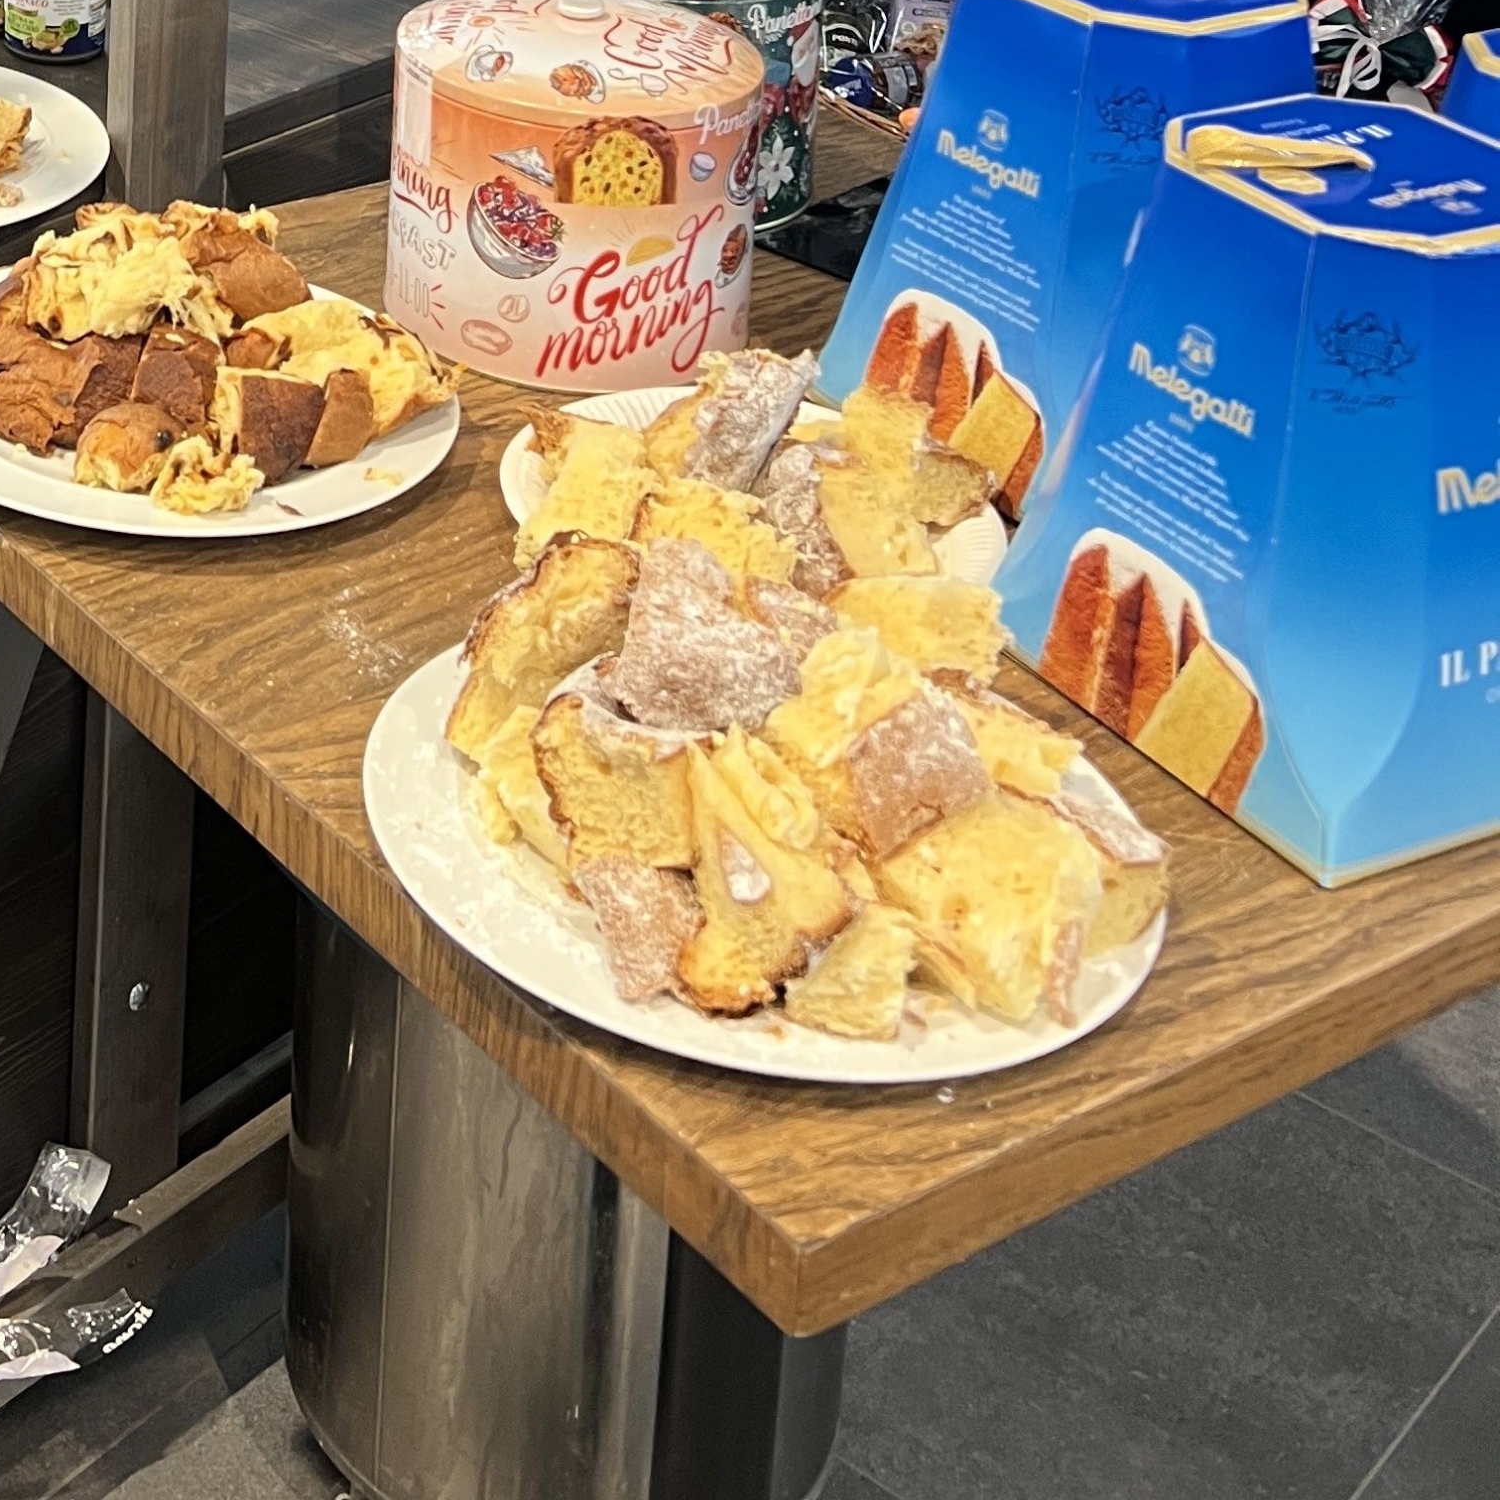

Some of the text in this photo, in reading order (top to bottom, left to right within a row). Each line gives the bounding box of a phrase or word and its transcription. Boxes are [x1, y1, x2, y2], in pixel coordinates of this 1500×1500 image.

[936, 128, 1041, 198] Melegatti
[547, 203, 725, 326] Good
[534, 278, 726, 378] morning
[1128, 341, 1257, 440] Melegatti
[1440, 649, 1471, 690] IL
